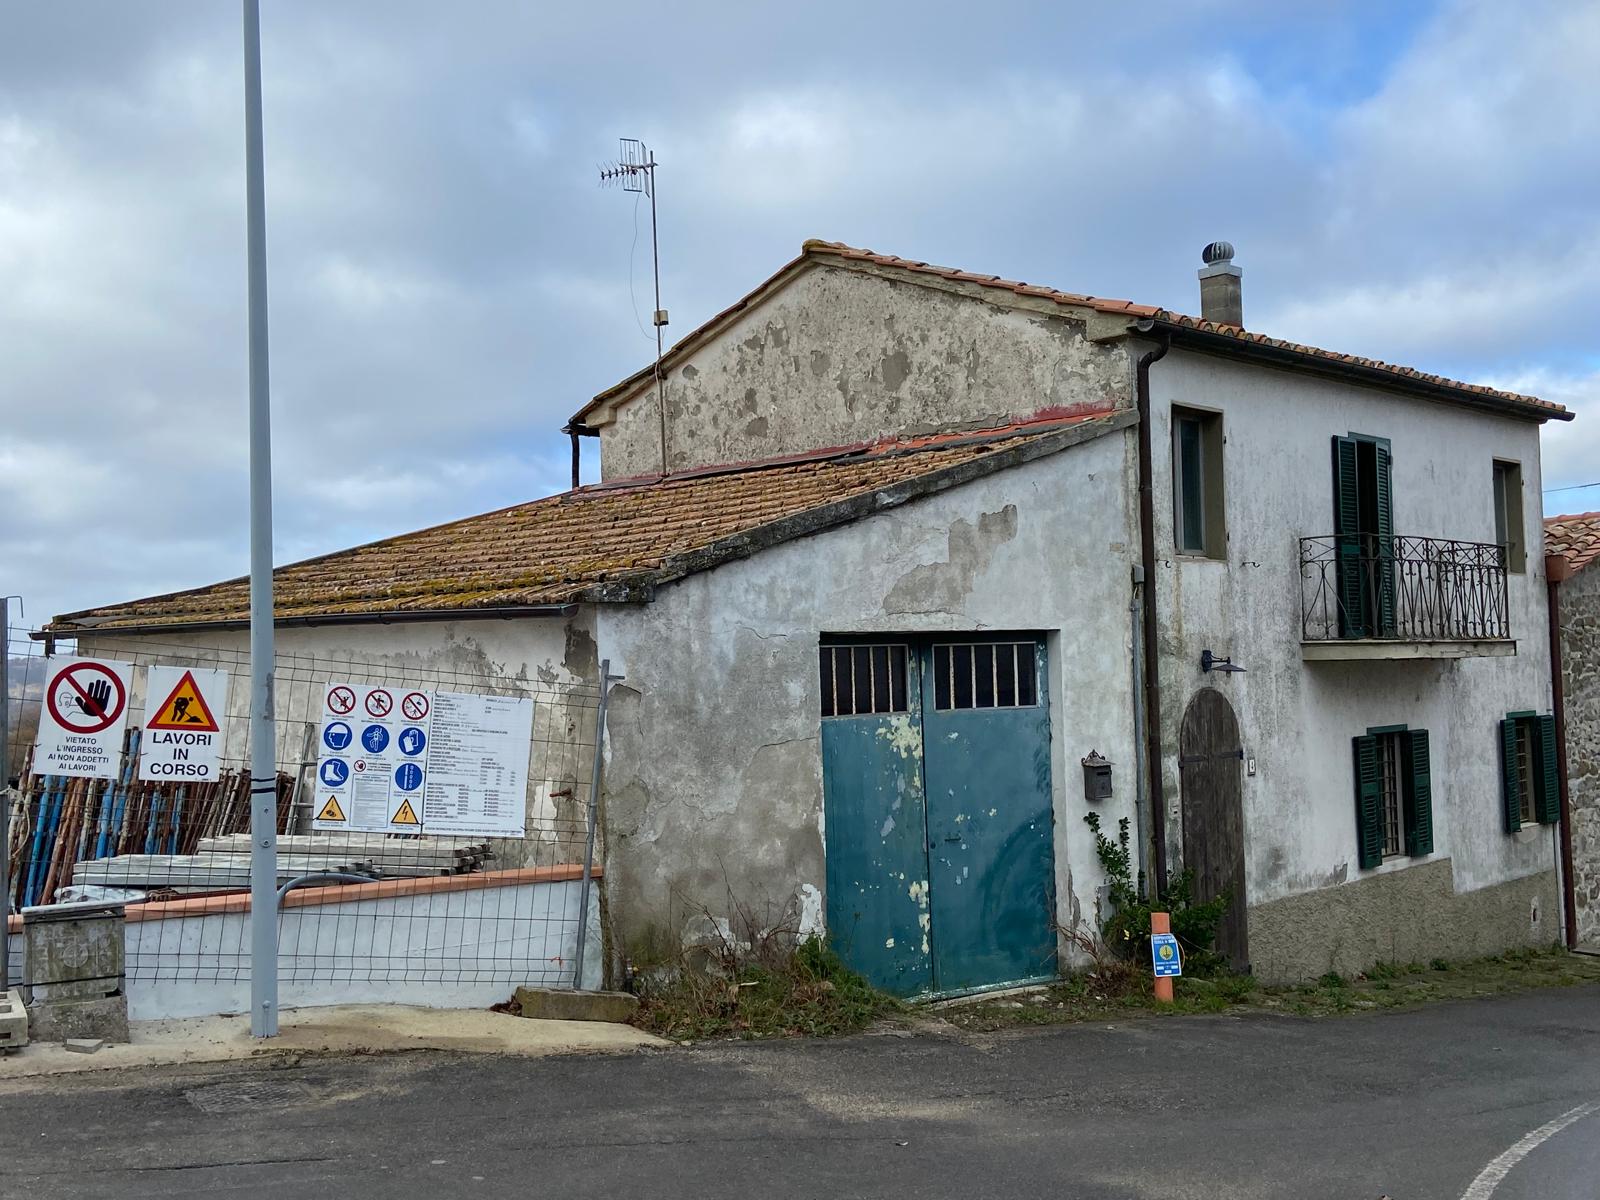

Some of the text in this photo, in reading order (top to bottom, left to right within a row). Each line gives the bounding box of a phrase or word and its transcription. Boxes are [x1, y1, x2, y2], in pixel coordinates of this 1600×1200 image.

[65, 736, 97, 745] VIETATO
[152, 732, 212, 746] LAVORI
[56, 745, 103, 755] L'INGRESSO
[173, 748, 189, 760] IN
[57, 754, 75, 762] NON
[76, 755, 109, 764] ADDETTI
[68, 764, 97, 772] LAVORI
[150, 763, 209, 776] CORSO
